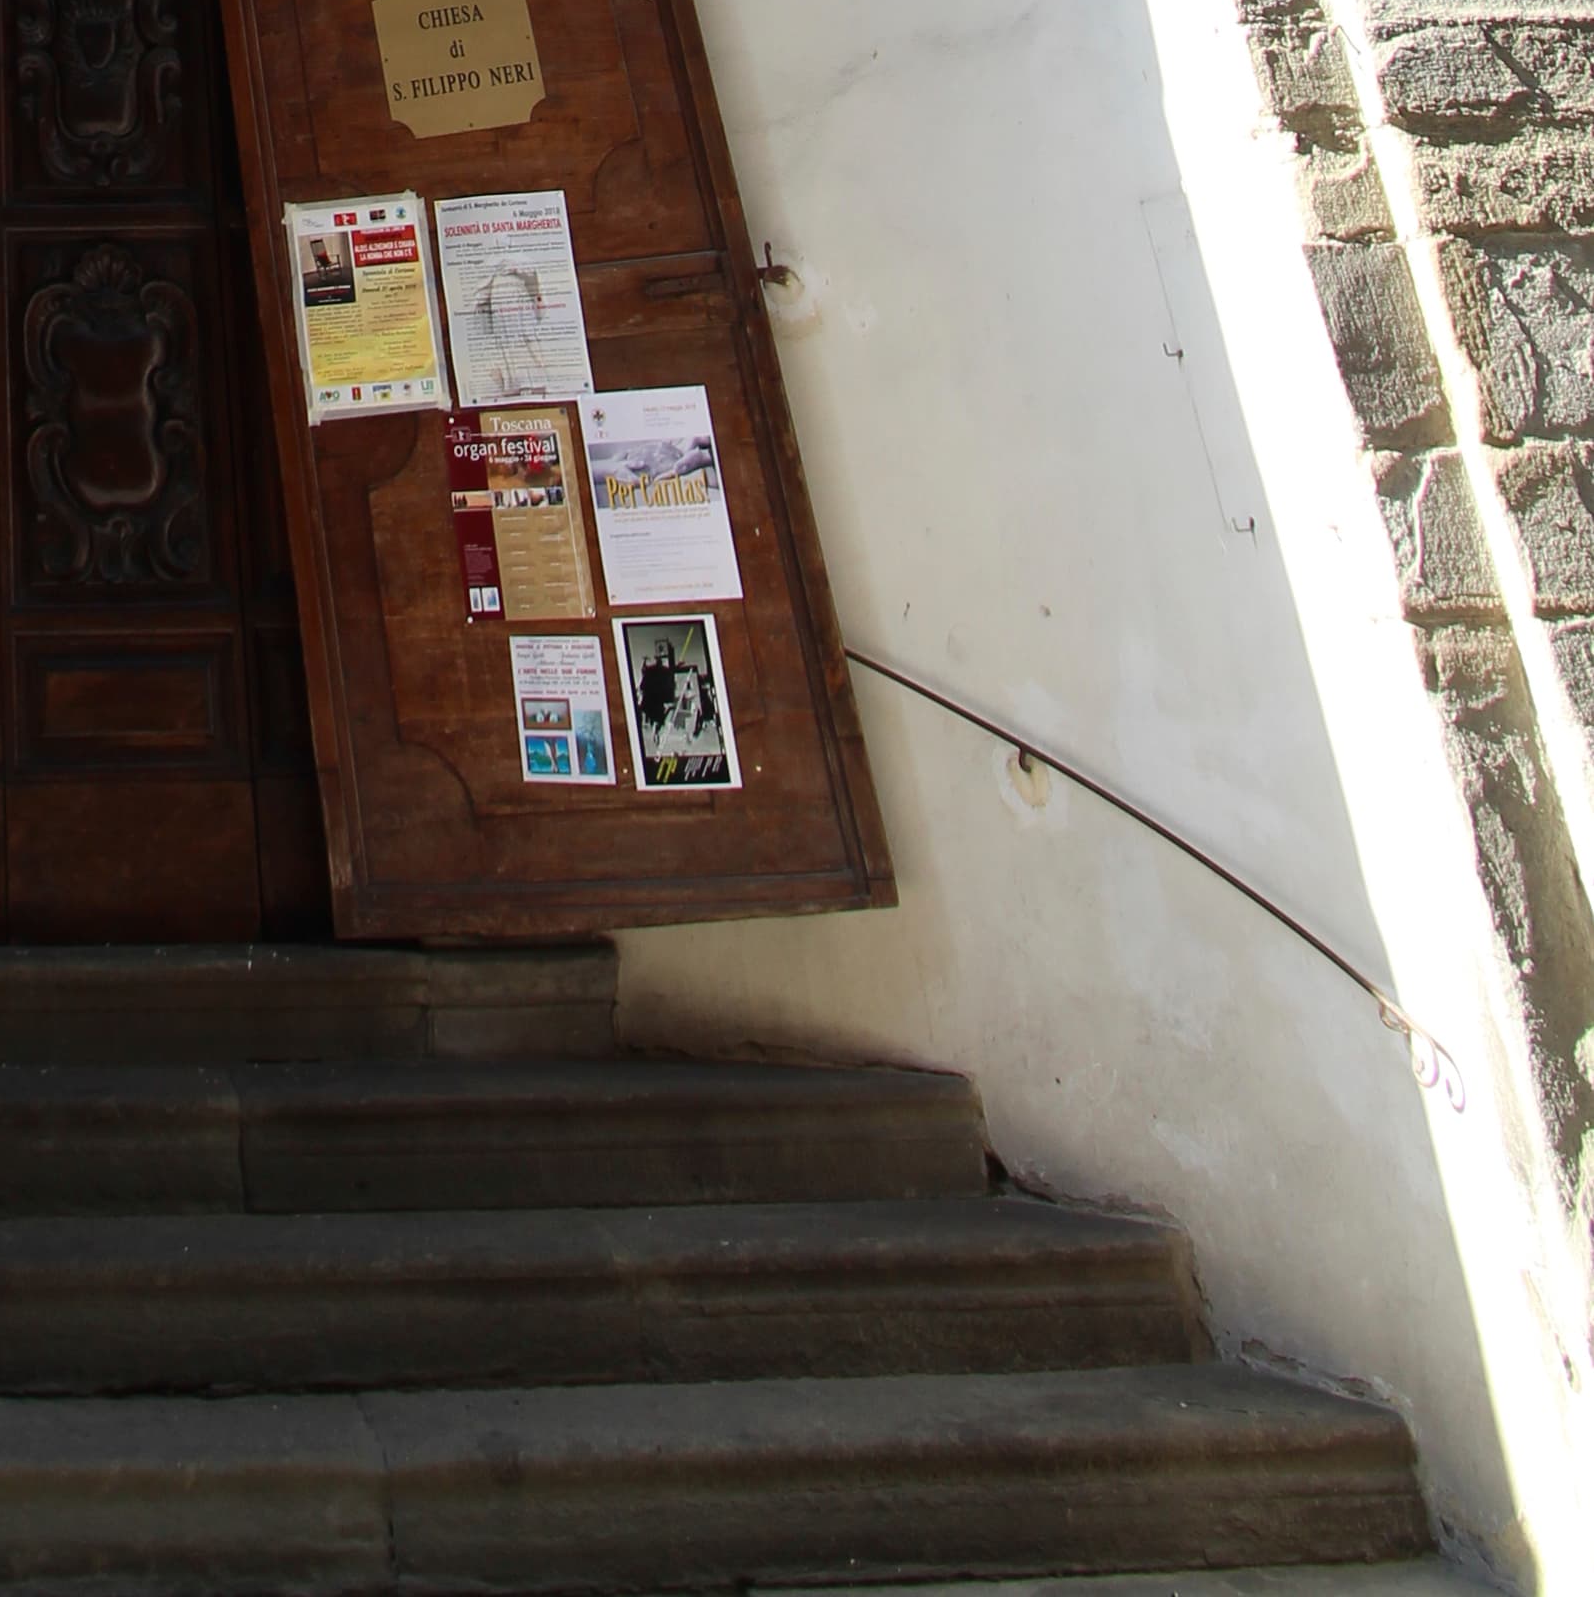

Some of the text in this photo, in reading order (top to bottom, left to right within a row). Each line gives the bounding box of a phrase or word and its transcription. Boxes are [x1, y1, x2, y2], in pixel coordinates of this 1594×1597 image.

[417, 4, 484, 30] CHIESA
[449, 39, 466, 59] di
[392, 61, 535, 102] S. FILIPPO NERI
[519, 208, 544, 220] Maggio
[544, 206, 561, 216] 2018
[444, 220, 482, 238] SOLENNITÀ
[482, 224, 491, 235] DI
[492, 221, 515, 234] SANTA
[516, 217, 562, 231] MARGHERITA
[489, 416, 552, 432] Toscana
[453, 435, 555, 462] organ festival
[494, 455, 520, 465] maggio
[533, 453, 557, 463] giugno
[605, 467, 711, 510] Per Caritas!
